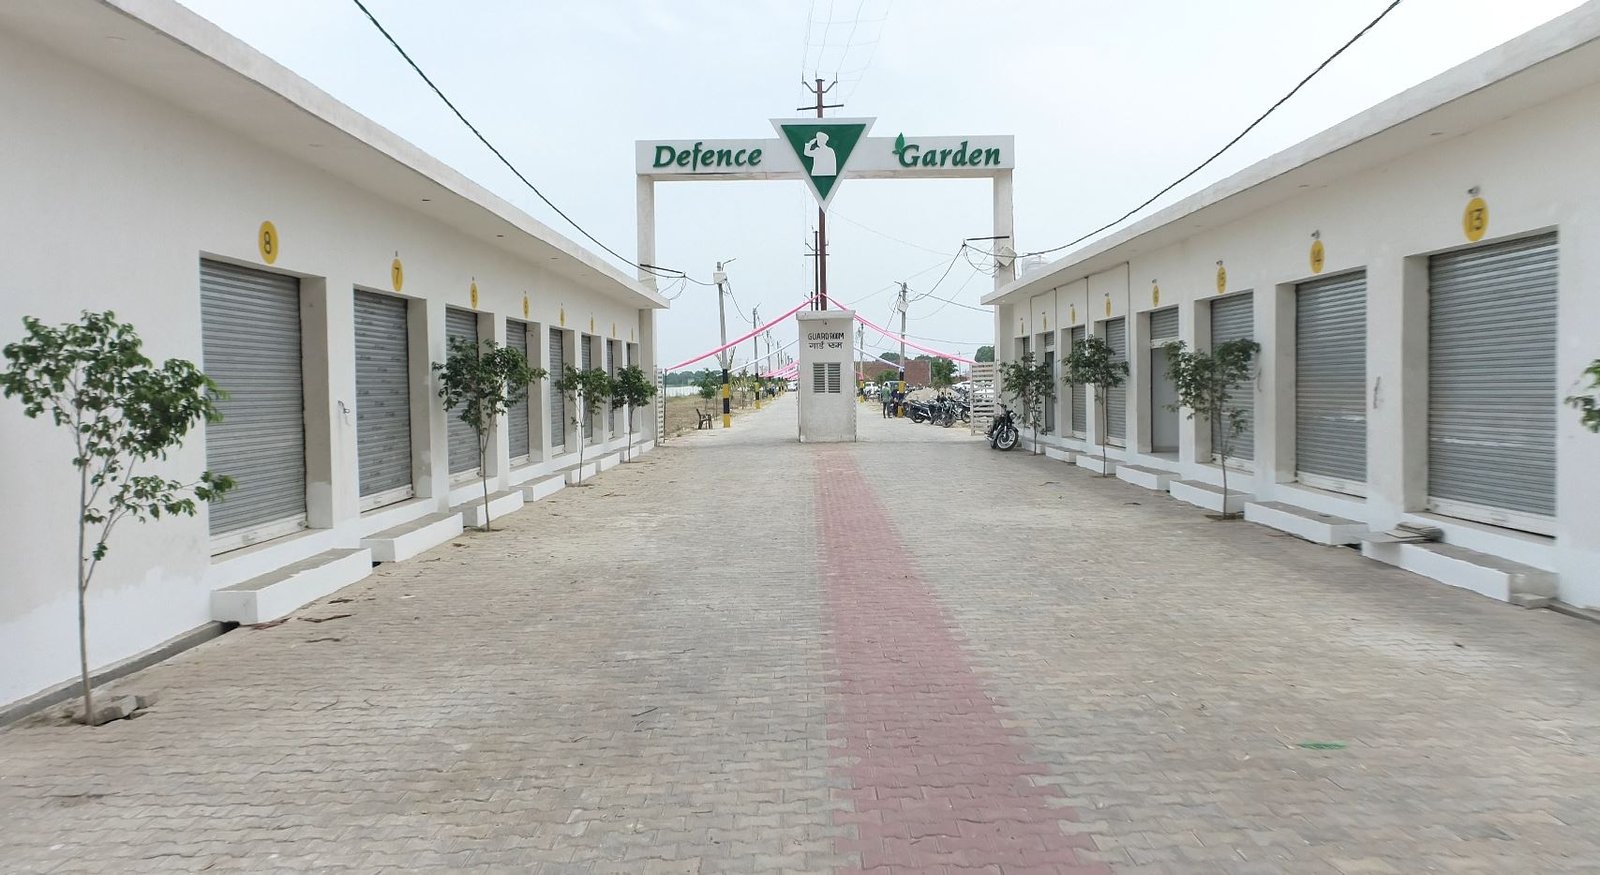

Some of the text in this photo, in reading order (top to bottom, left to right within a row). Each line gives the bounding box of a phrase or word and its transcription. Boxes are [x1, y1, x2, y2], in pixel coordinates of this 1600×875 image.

[653, 140, 1001, 171] Defence Garden
[1468, 207, 1485, 232] 13
[263, 231, 273, 255] 8
